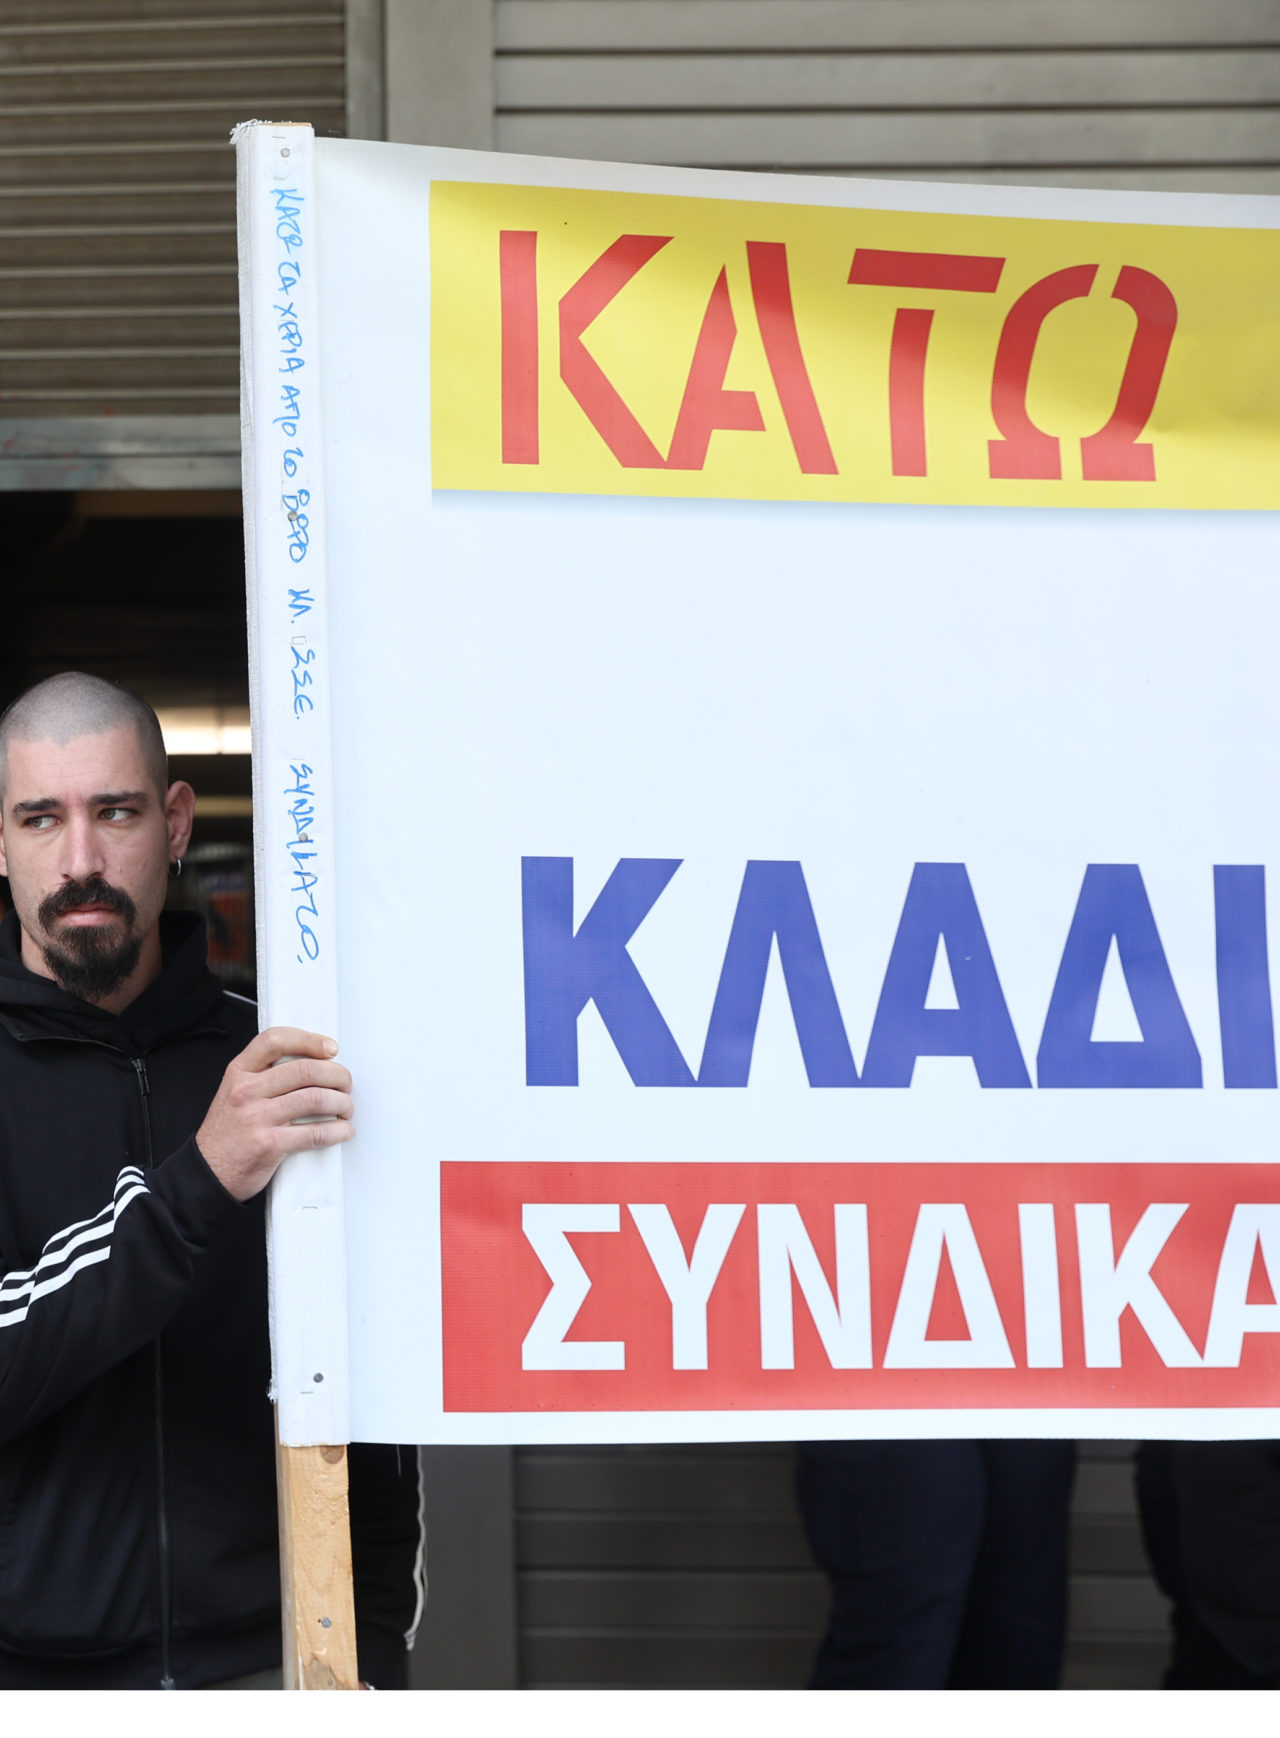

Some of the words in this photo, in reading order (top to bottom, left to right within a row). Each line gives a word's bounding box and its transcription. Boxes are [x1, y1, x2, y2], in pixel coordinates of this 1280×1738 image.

[498, 229, 1179, 482] ΚΑΤΩ
[520, 856, 1279, 1089] ΚΛΑΔΙ
[521, 1202, 1280, 1371] ΣΥΝΔΙΚΑ
